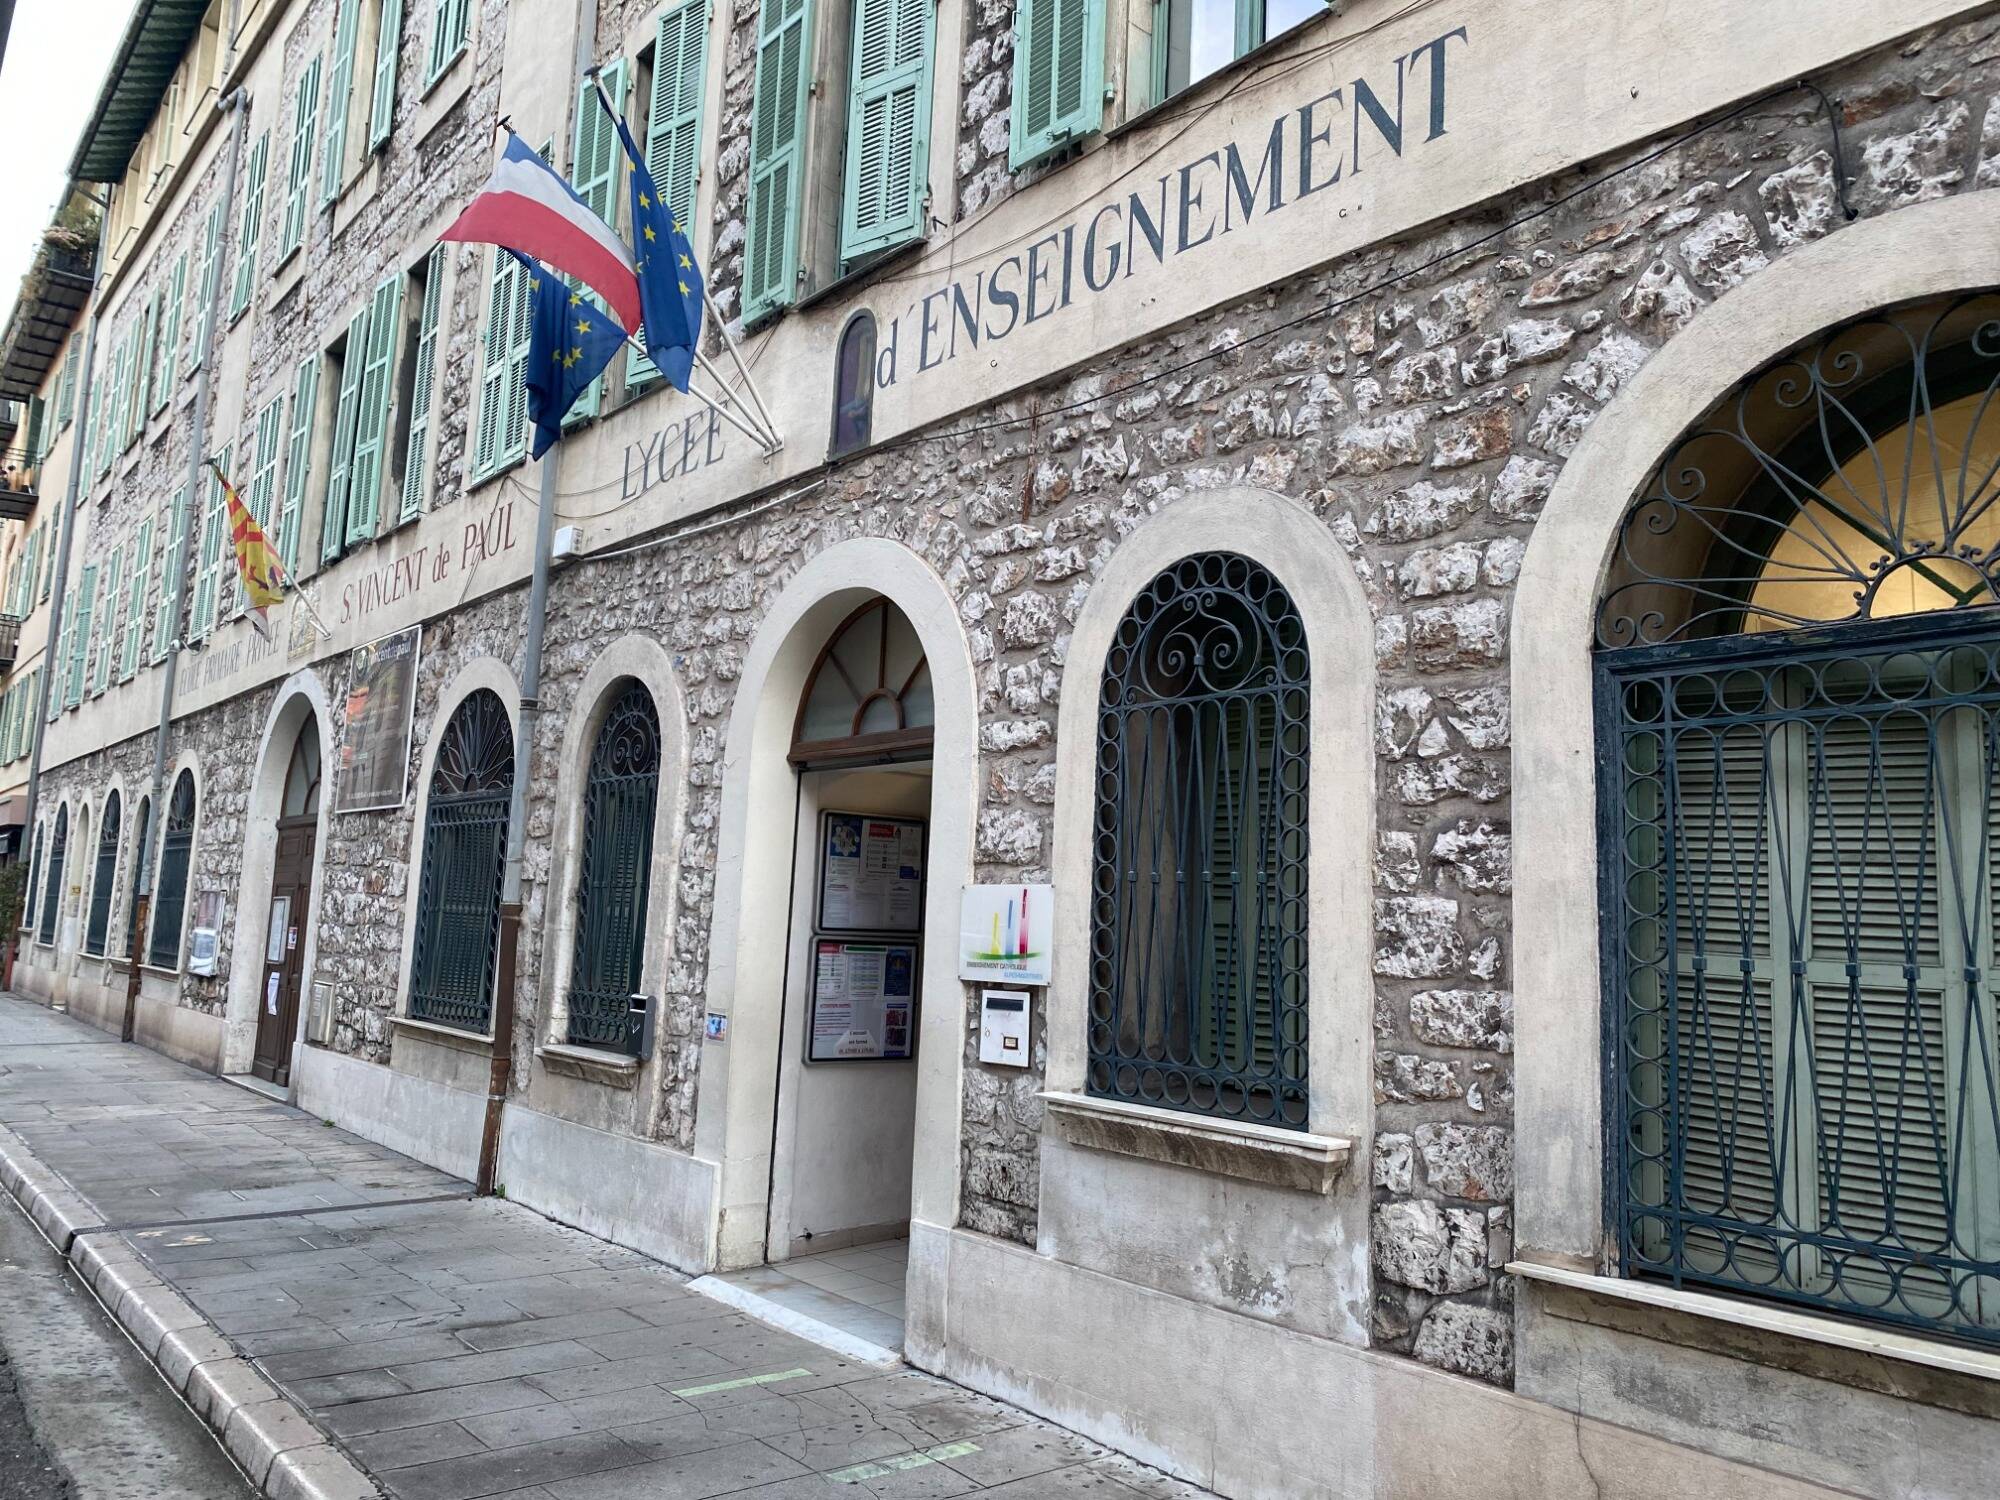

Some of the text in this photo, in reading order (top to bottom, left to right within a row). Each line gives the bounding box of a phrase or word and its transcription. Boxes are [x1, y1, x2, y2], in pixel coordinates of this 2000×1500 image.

[358, 546, 428, 619] VINCENT
[432, 542, 451, 583] de
[461, 501, 517, 570] PAUL
